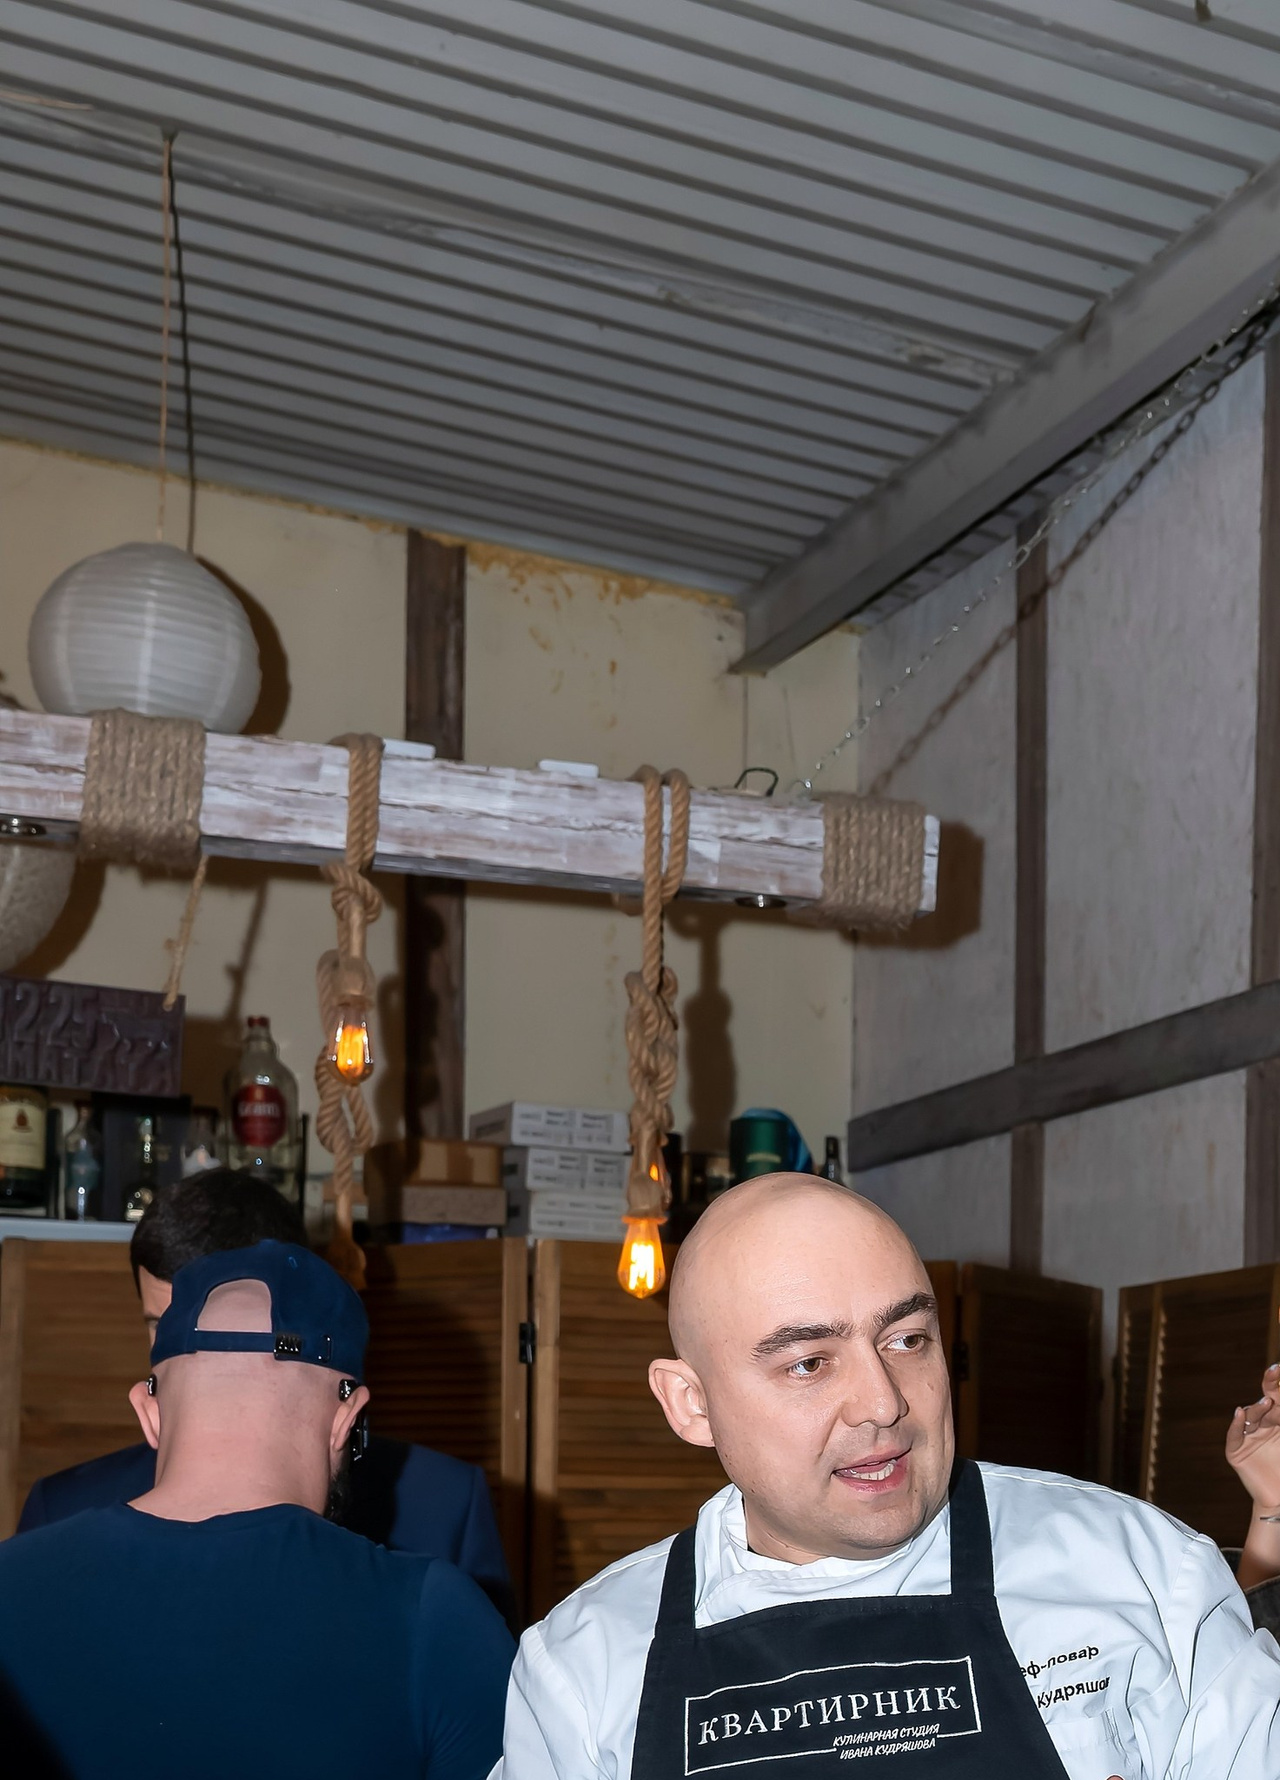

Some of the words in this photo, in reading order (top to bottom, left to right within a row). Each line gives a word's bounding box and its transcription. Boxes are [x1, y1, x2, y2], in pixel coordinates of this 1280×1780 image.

[1020, 1646, 1099, 1679] еф-повар
[698, 1686, 961, 1745] КВАРТИРНИК
[833, 1728, 899, 1746] КУЛИНАРНАЯ
[900, 1723, 940, 1739] СТУДИЯ
[840, 1745, 873, 1760] ИВАНА
[874, 1738, 936, 1756] КУДРЯШОВА
